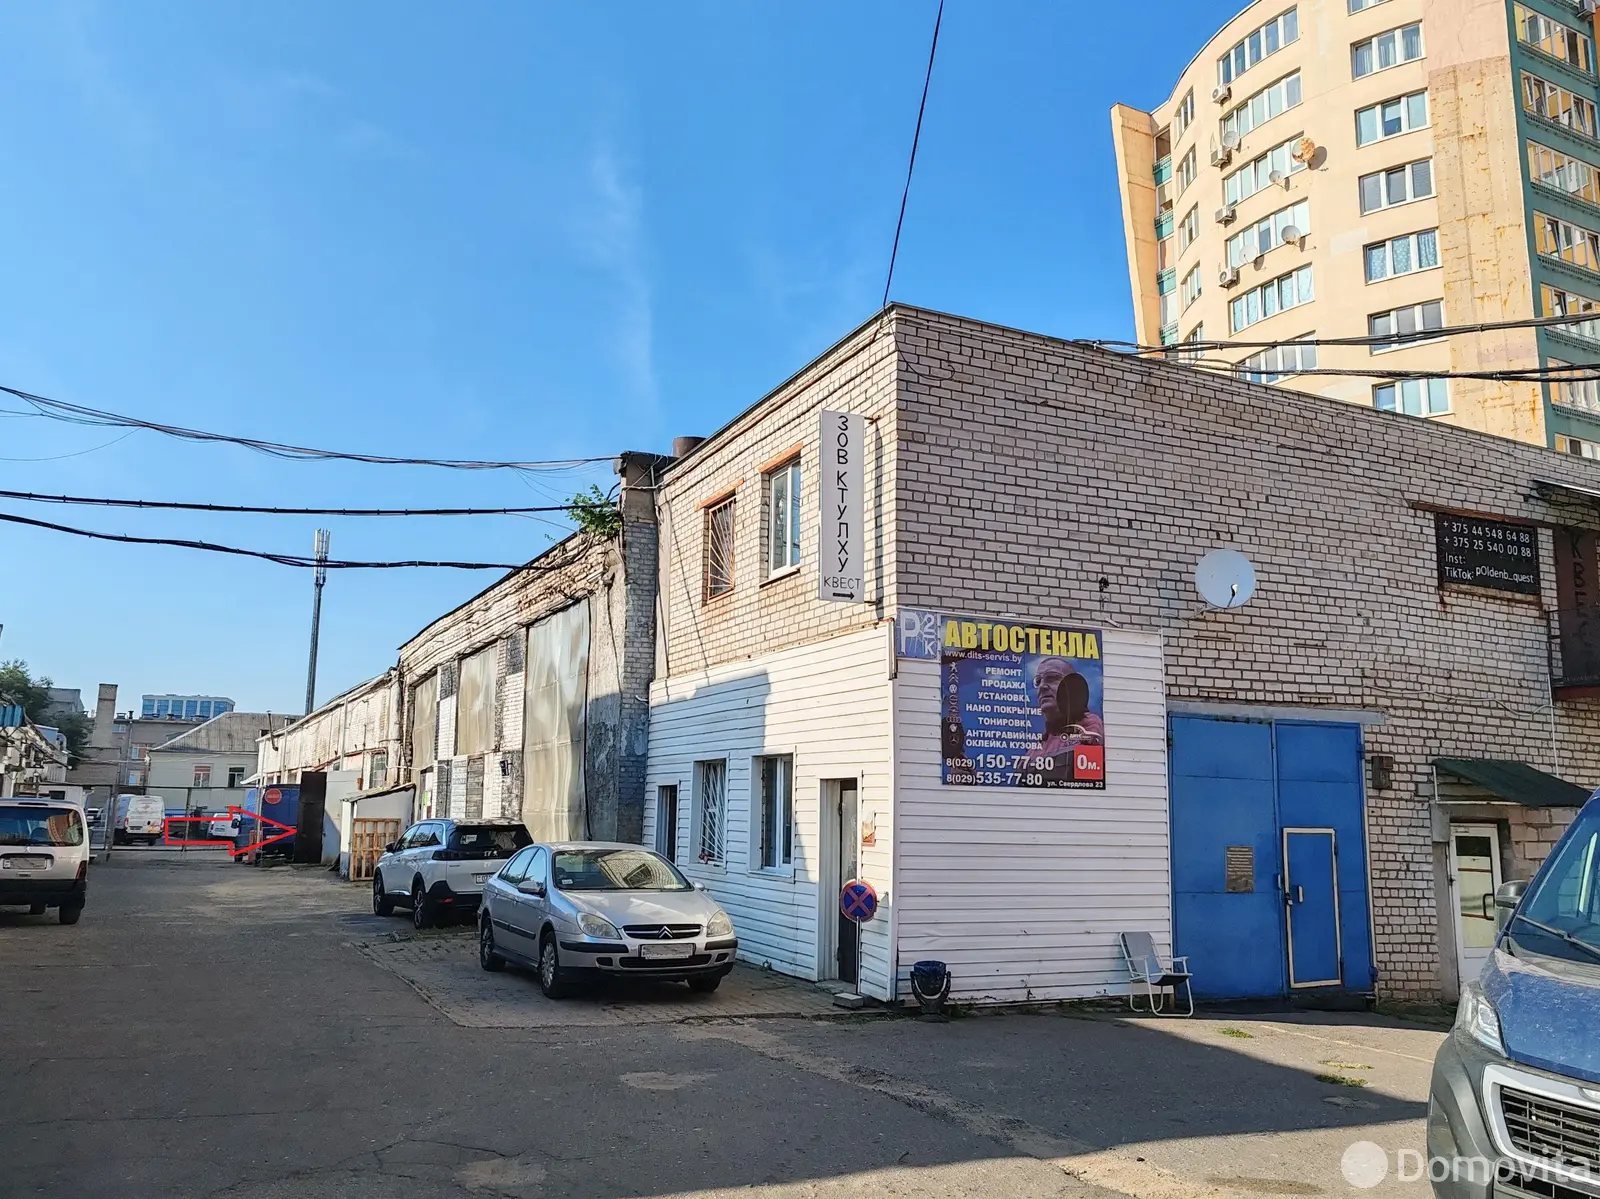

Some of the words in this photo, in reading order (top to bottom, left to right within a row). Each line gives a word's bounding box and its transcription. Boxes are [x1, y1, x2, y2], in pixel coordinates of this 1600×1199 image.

[837, 415, 849, 464] ЗОВ
[837, 470, 849, 573] КТУЛХУ
[1451, 522, 1468, 534] 375
[1472, 526, 1483, 536] 44
[1485, 527, 1503, 539] 548
[1506, 530, 1517, 541] 64
[1519, 532, 1530, 543] 88
[1453, 536, 1469, 548] 375
[1473, 539, 1484, 550] 25
[1487, 541, 1504, 553] 540
[1507, 545, 1518, 556] 00
[1521, 546, 1531, 557] 88
[1445, 552, 1466, 564] Inst:
[1445, 566, 1474, 580] TikTok:
[824, 576, 861, 590] КВЕСТ
[945, 620, 1100, 659] АВТОСТЕКЛА
[945, 649, 1022, 664] www.dits-servis.by
[985, 667, 1022, 676] РЕМОНТ
[982, 679, 1026, 689] ПРОДАЖА
[978, 692, 1030, 702] УСТАНОВКА
[966, 704, 991, 712] НАНО
[994, 705, 1042, 715] ПОКРЫТИЕ
[978, 717, 1032, 727] ТОНИРОВКА
[966, 729, 1043, 741] АНТИГРАВИЙНАЯ
[966, 739, 1007, 749] ОКЛЕЙКА
[1010, 741, 1043, 750] КУЗОВА
[1058, 780, 1094, 788] Свердлова
